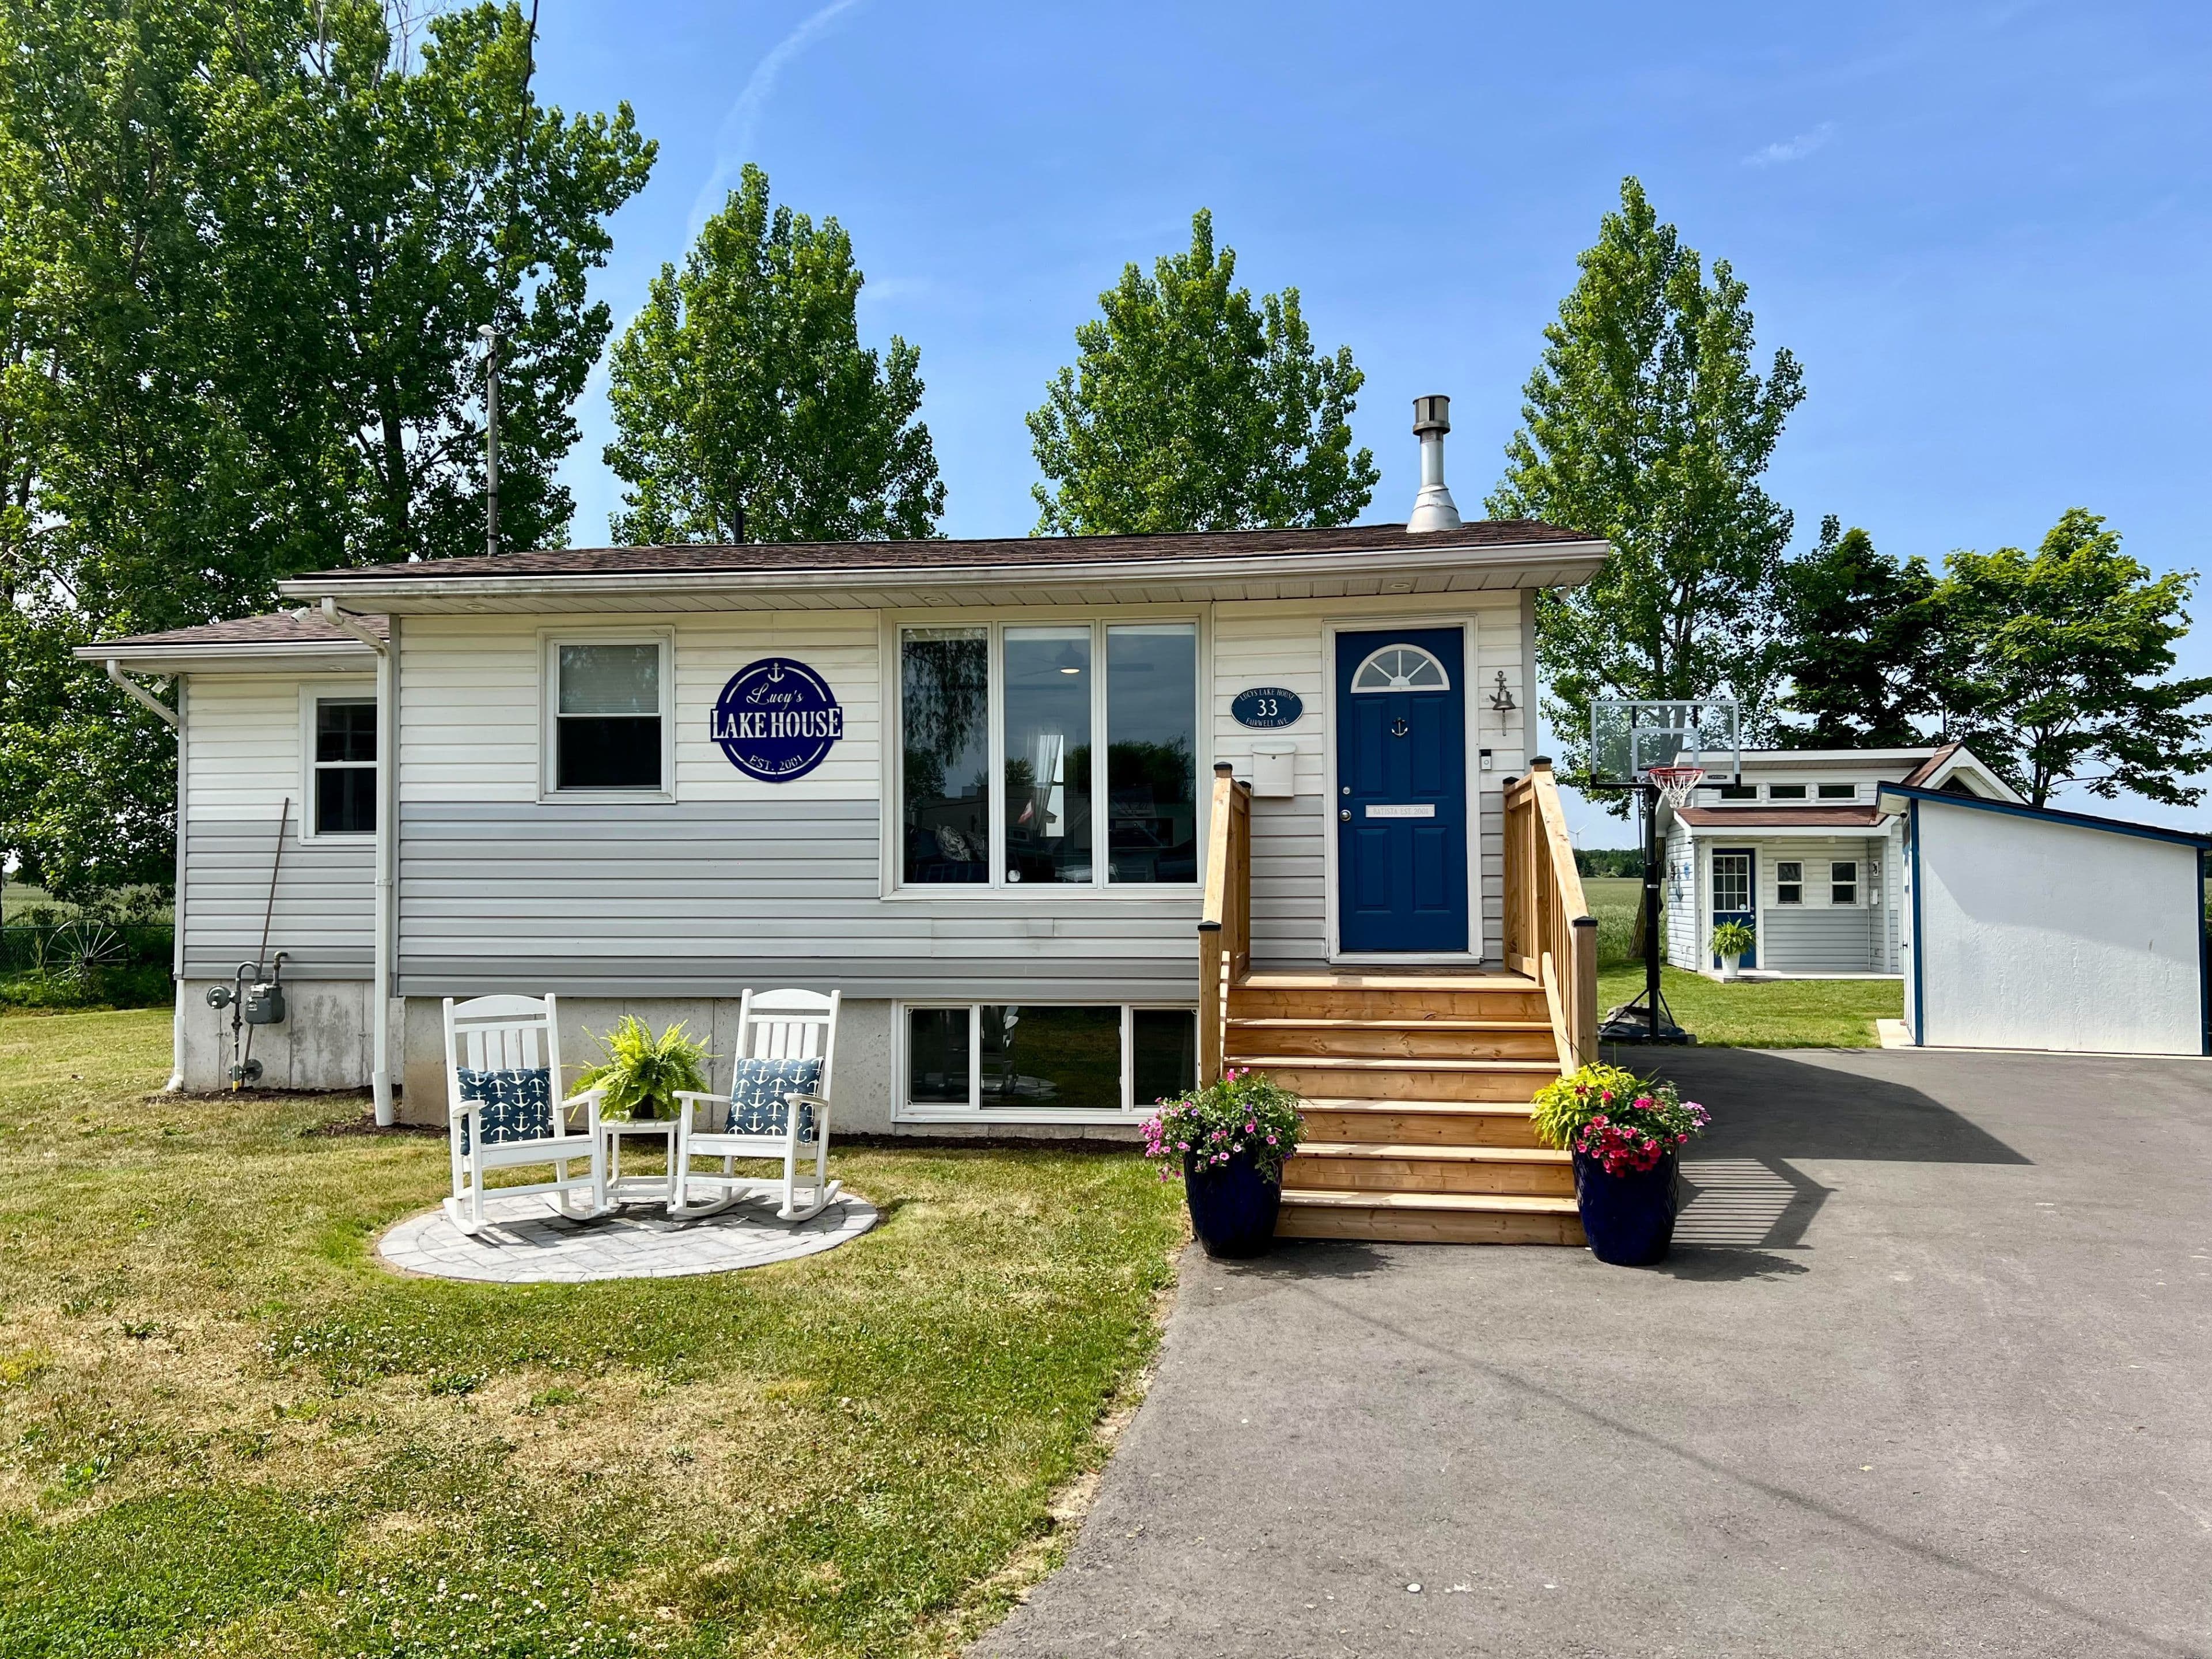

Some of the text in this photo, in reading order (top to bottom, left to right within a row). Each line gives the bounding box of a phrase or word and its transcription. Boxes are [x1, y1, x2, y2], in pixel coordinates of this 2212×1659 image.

[746, 683, 804, 710] Lucy's
[1240, 690, 1258, 701] LUCYS
[1277, 689, 1296, 700] HOUSE
[1257, 699, 1278, 716] 33
[712, 708, 841, 738] LAKE HOUSE
[1245, 717, 1289, 726] FAIRWELL AVE
[748, 755, 803, 771] EST. 2001
